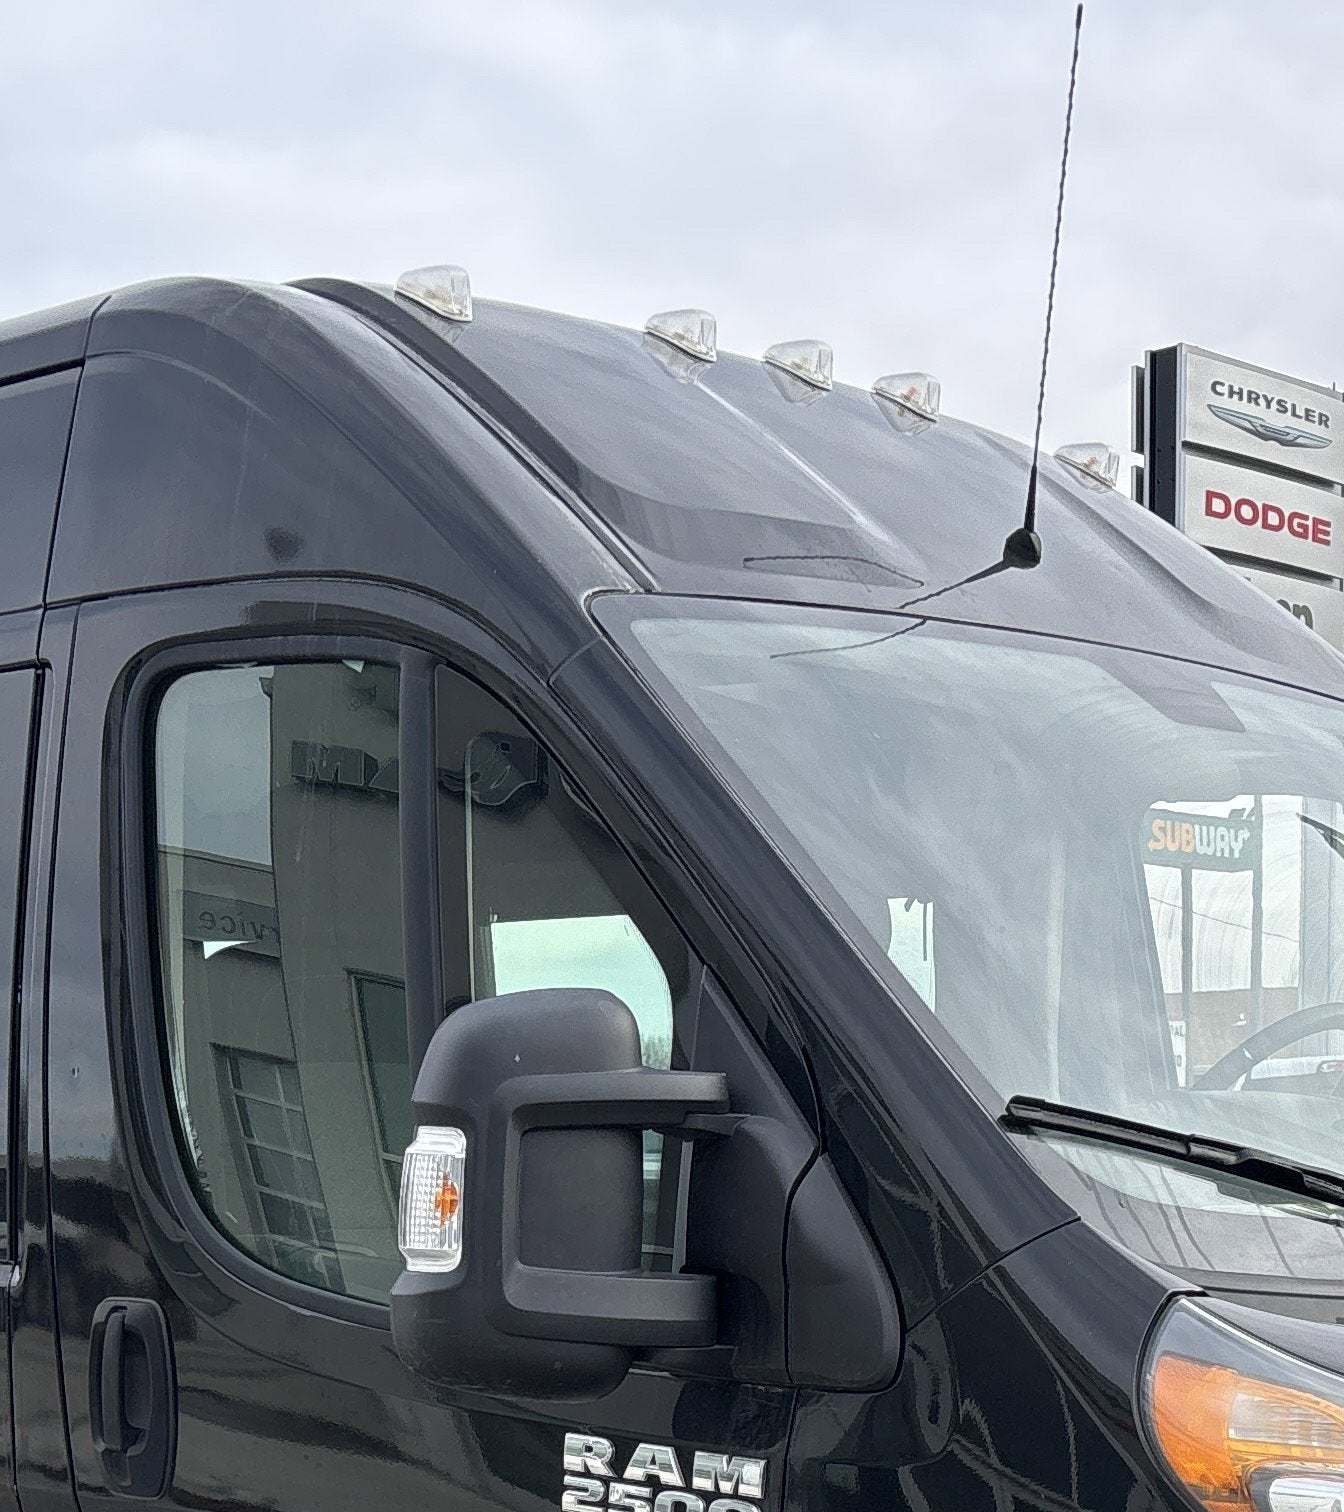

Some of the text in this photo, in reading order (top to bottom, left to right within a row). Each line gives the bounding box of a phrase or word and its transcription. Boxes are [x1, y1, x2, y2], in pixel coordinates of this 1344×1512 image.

[1210, 380, 1330, 429] CHRYSLER
[1205, 489, 1332, 546] DODGE
[1148, 818, 1250, 859] SUBWAY
[563, 1432, 768, 1499] RAM
